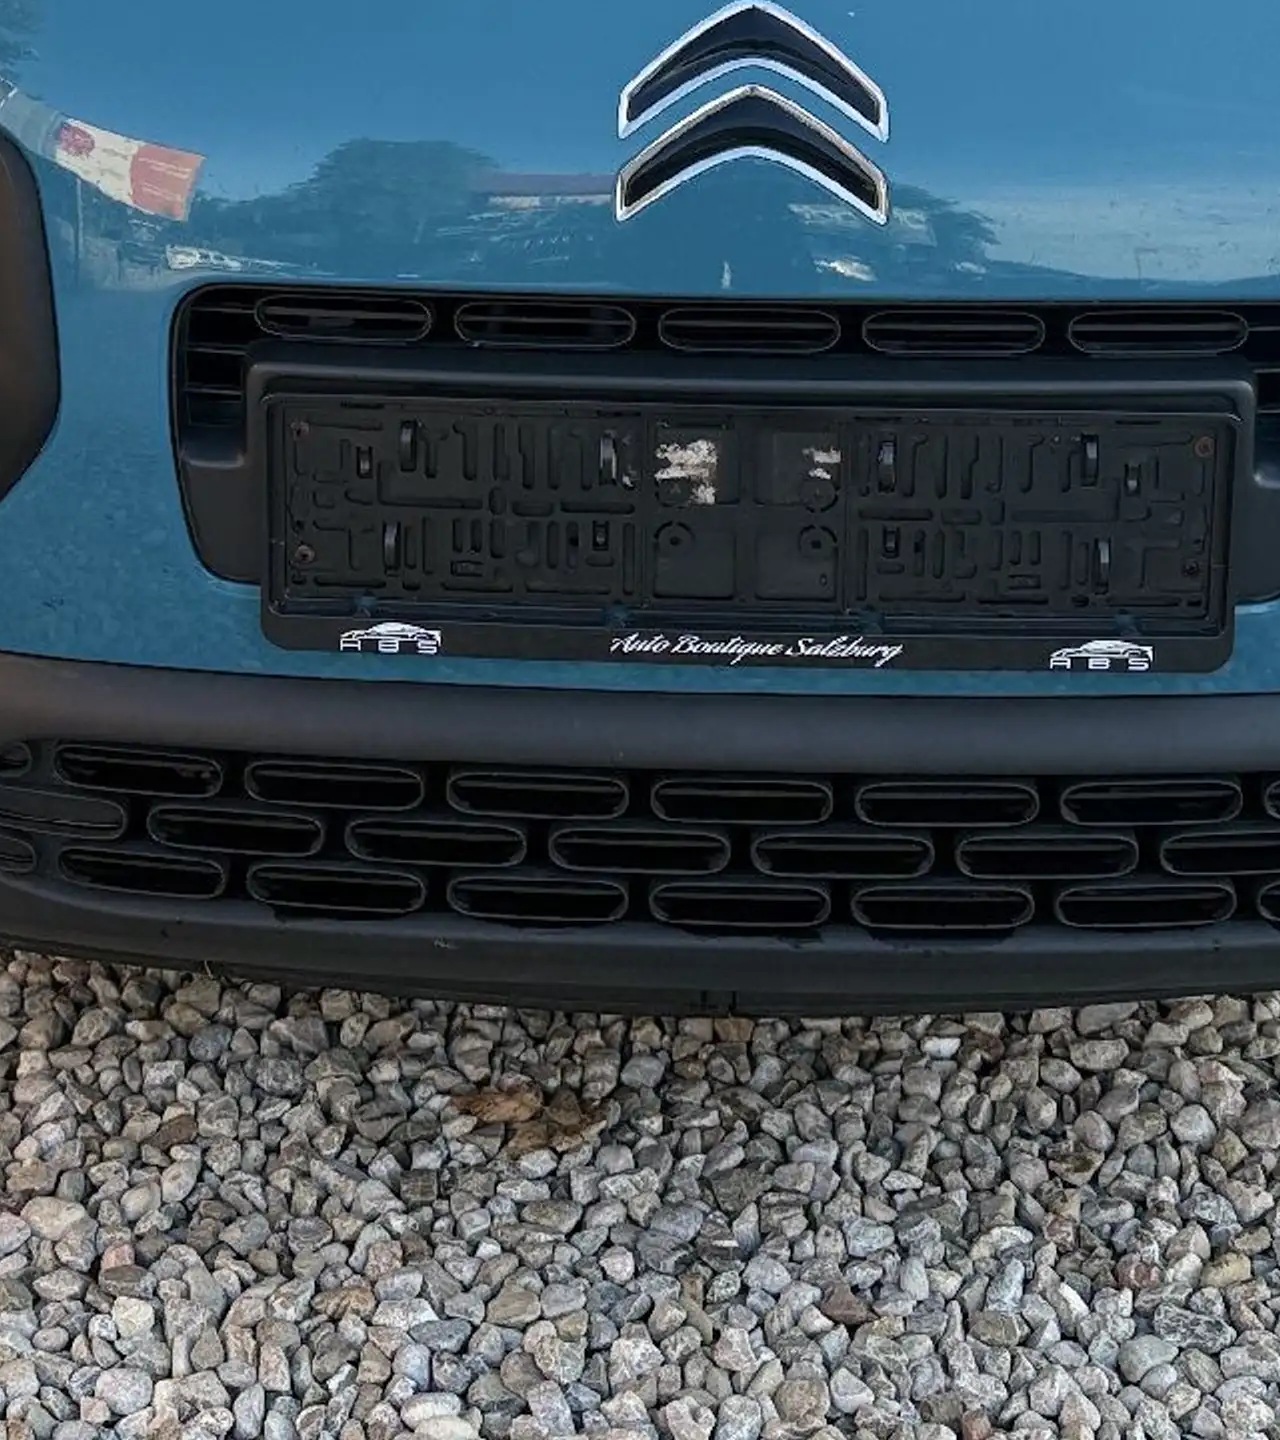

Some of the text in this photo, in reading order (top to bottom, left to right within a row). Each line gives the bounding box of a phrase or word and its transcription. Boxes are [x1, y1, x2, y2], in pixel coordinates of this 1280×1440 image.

[609, 632, 903, 668] Auto Boutique Salzburg
